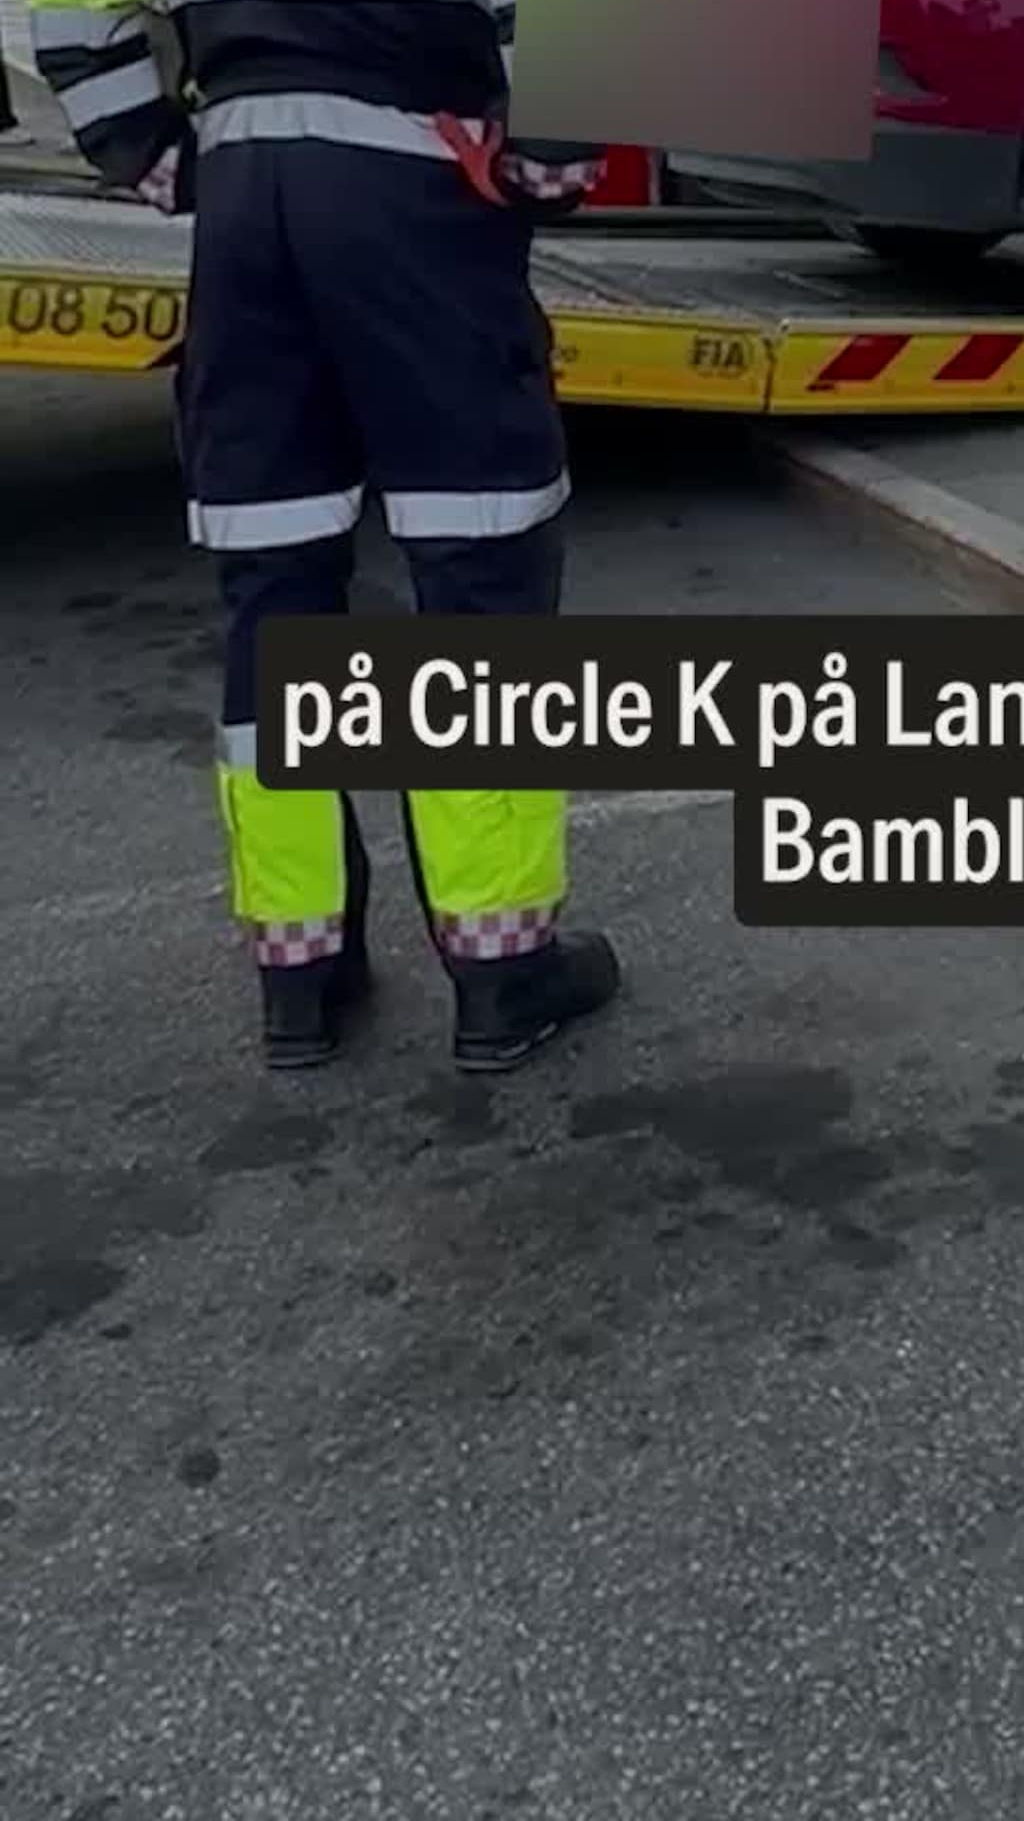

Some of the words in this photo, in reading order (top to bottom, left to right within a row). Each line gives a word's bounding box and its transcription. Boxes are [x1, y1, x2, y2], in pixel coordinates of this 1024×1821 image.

[8, 281, 85, 337] 08
[101, 287, 181, 341] 50
[692, 335, 746, 369] FIA
